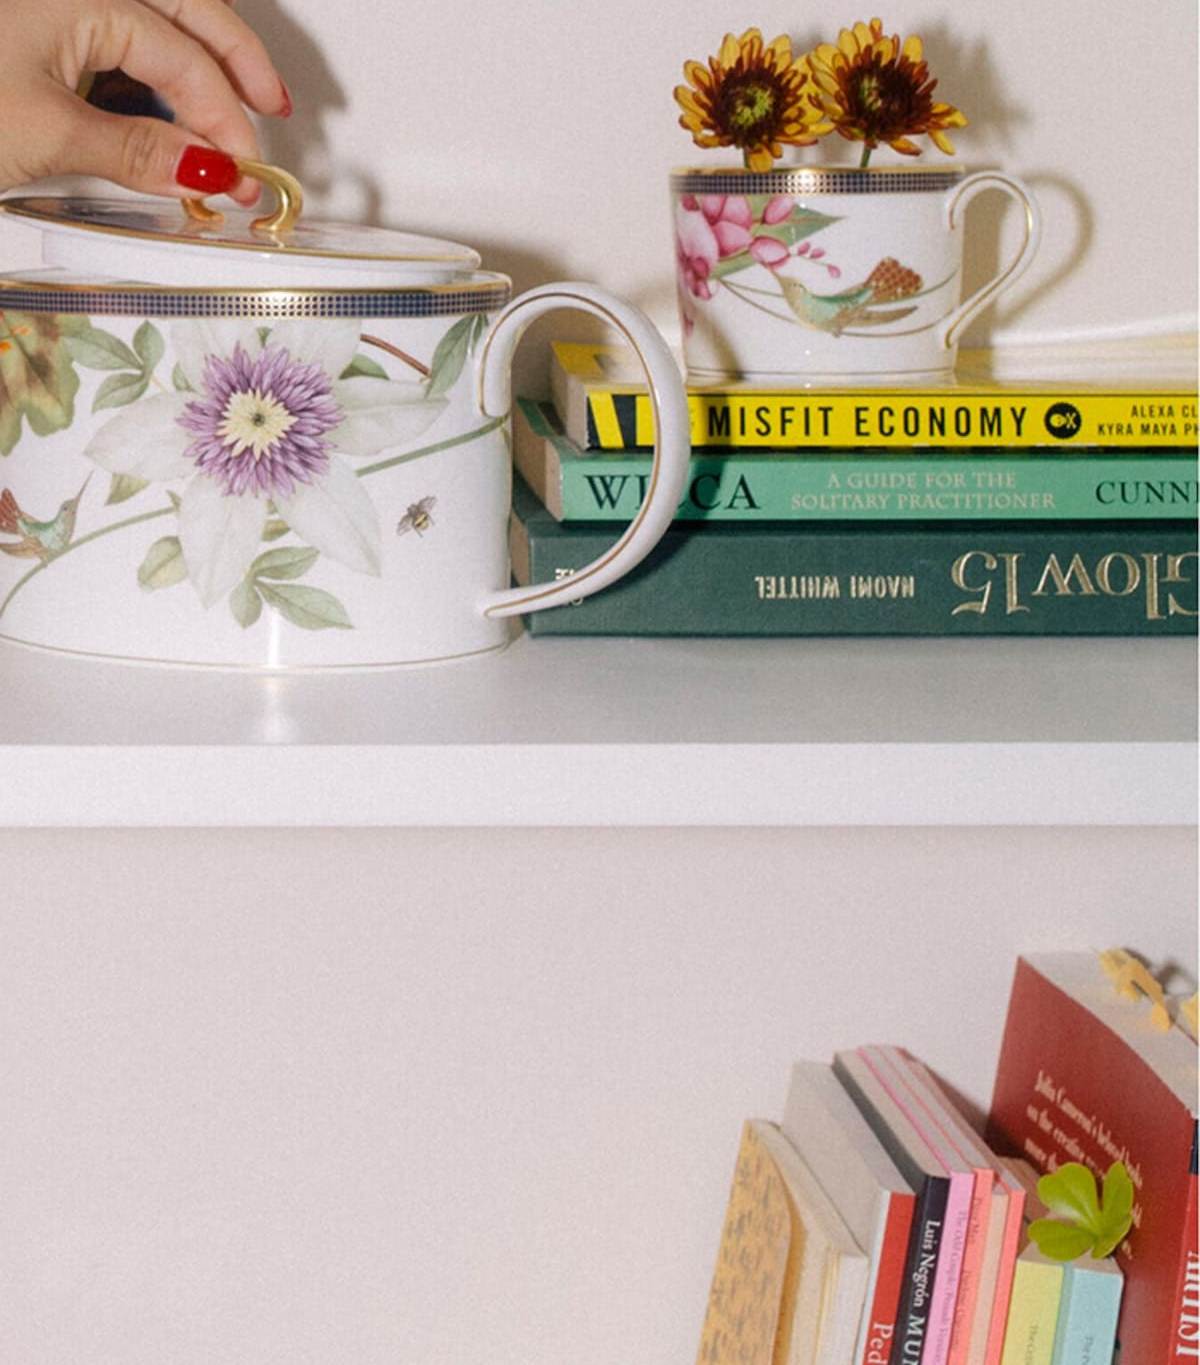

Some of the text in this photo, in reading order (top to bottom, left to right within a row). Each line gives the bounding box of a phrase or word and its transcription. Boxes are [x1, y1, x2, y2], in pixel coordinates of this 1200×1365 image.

[708, 406, 833, 437] MISFIT
[854, 406, 1027, 437] ECONOMY
[1131, 404, 1175, 418] ALEXA
[1098, 422, 1134, 436] KYRA
[1140, 422, 1178, 436] MAYA
[584, 473, 761, 511] WICA
[827, 471, 1017, 489] A GUIDE FOR THE
[791, 492, 1056, 510] SOLITARY PRACTITIONER
[754, 575, 915, 599] NAOMI WHITTEL
[951, 550, 1198, 620] Glow15
[922, 1219, 941, 1251] Luis
[911, 1253, 937, 1308] Negrón
